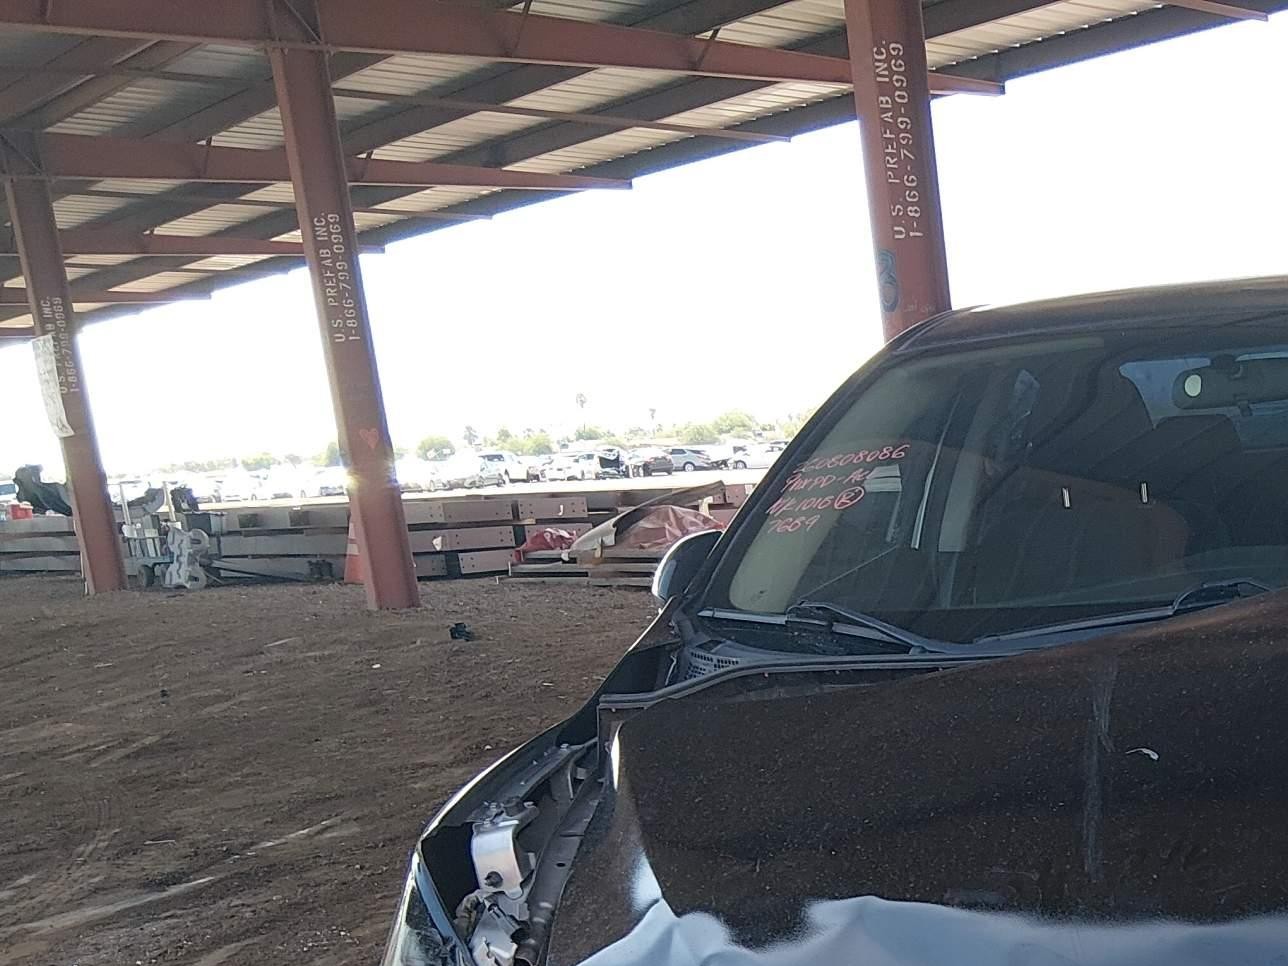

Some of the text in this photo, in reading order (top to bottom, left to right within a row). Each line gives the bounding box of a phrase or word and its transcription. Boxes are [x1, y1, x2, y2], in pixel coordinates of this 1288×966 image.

[872, 39, 907, 240] U.S. PREFAB INC.
[888, 42, 924, 238] 1-866-799-0969
[313, 212, 346, 343] U.S. PREFAB INC.
[327, 213, 360, 340] 1-866-799-0969
